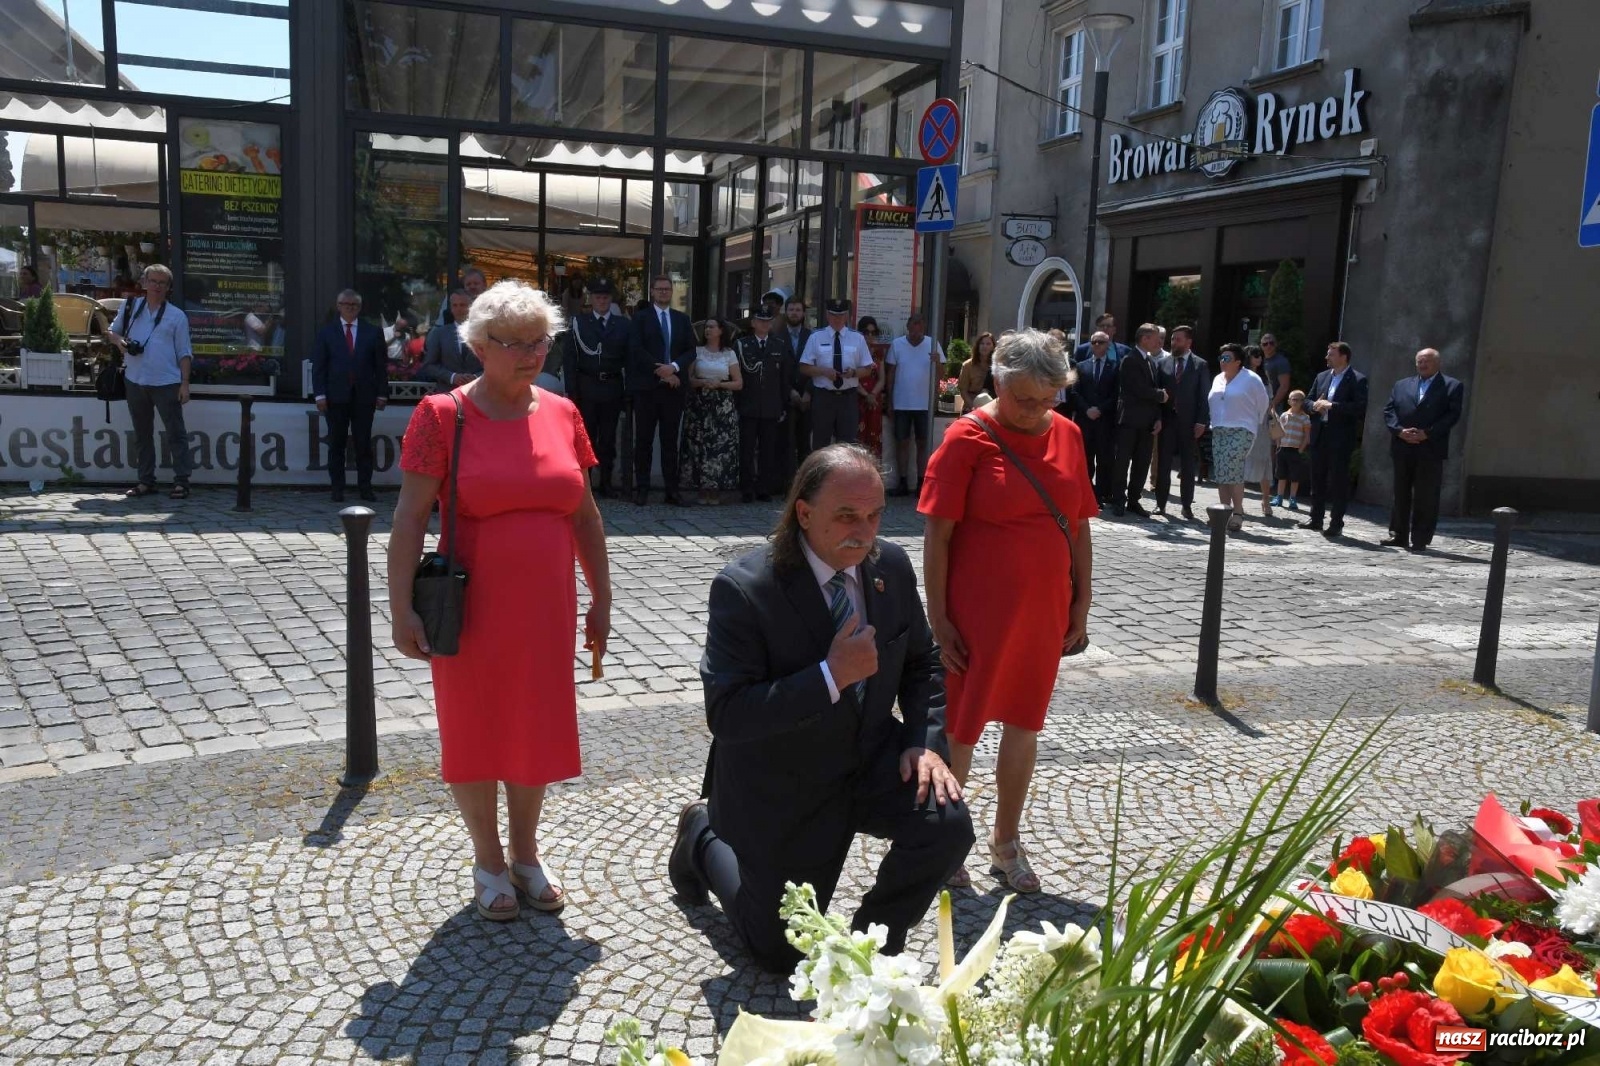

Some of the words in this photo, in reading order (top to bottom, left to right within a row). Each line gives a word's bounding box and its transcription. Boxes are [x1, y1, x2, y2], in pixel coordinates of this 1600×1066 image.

[1108, 132, 1193, 184] Browar
[1254, 68, 1364, 155] Rynek
[182, 172, 223, 192] CATERING
[225, 176, 279, 197] DIETETYCZNY
[224, 200, 239, 211] BEZ
[241, 202, 279, 213] PSZENICY
[869, 210, 908, 222] LUNCH
